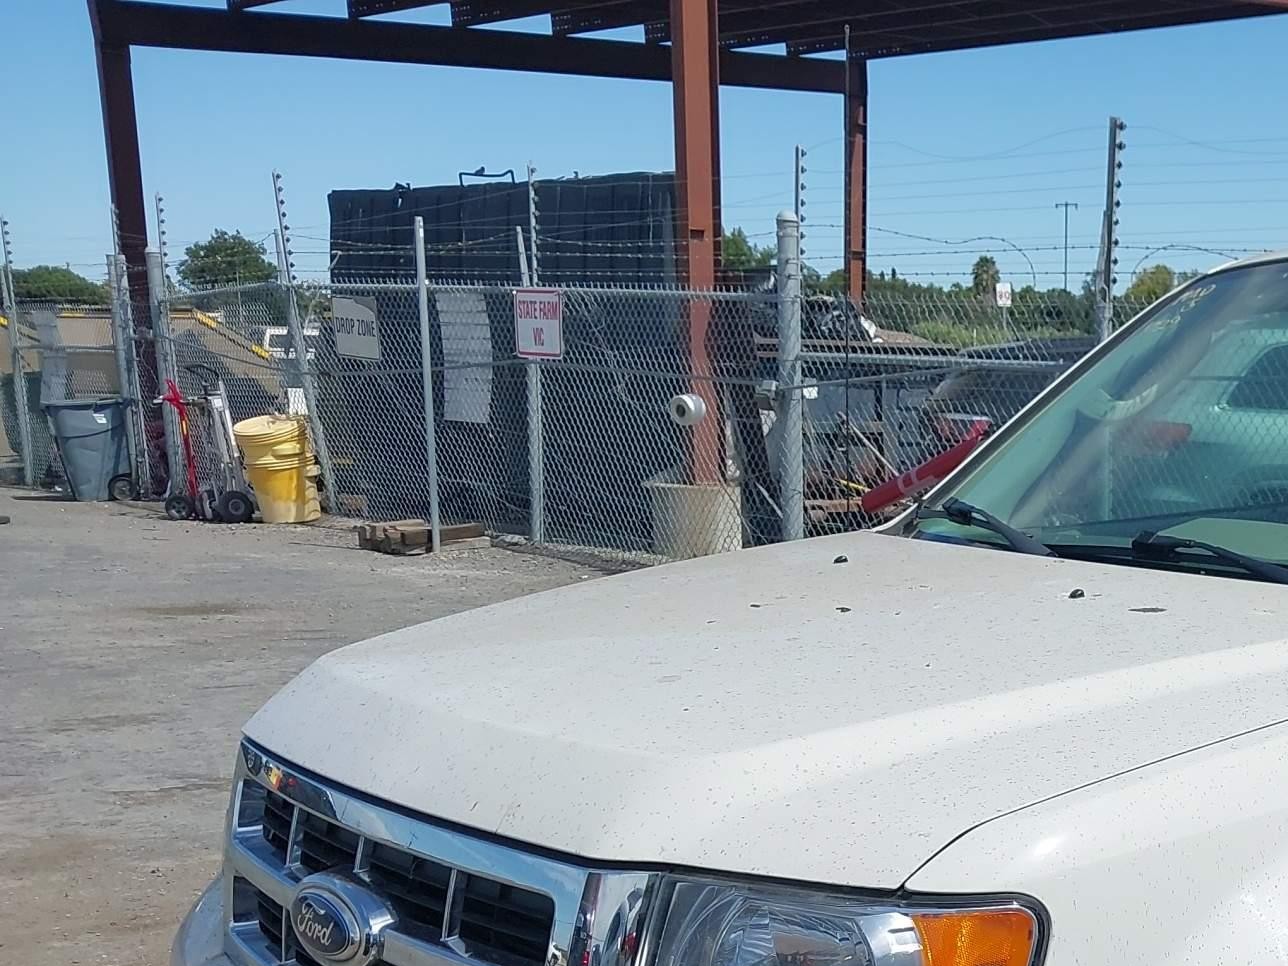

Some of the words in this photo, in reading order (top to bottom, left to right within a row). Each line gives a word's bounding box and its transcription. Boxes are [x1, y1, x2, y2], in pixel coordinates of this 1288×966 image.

[518, 300, 538, 319] STATE
[540, 301, 559, 320] FARM
[335, 317, 354, 334] DROP
[357, 319, 376, 337] ZONE
[532, 327, 544, 346] VIC
[298, 900, 334, 946] Ford
